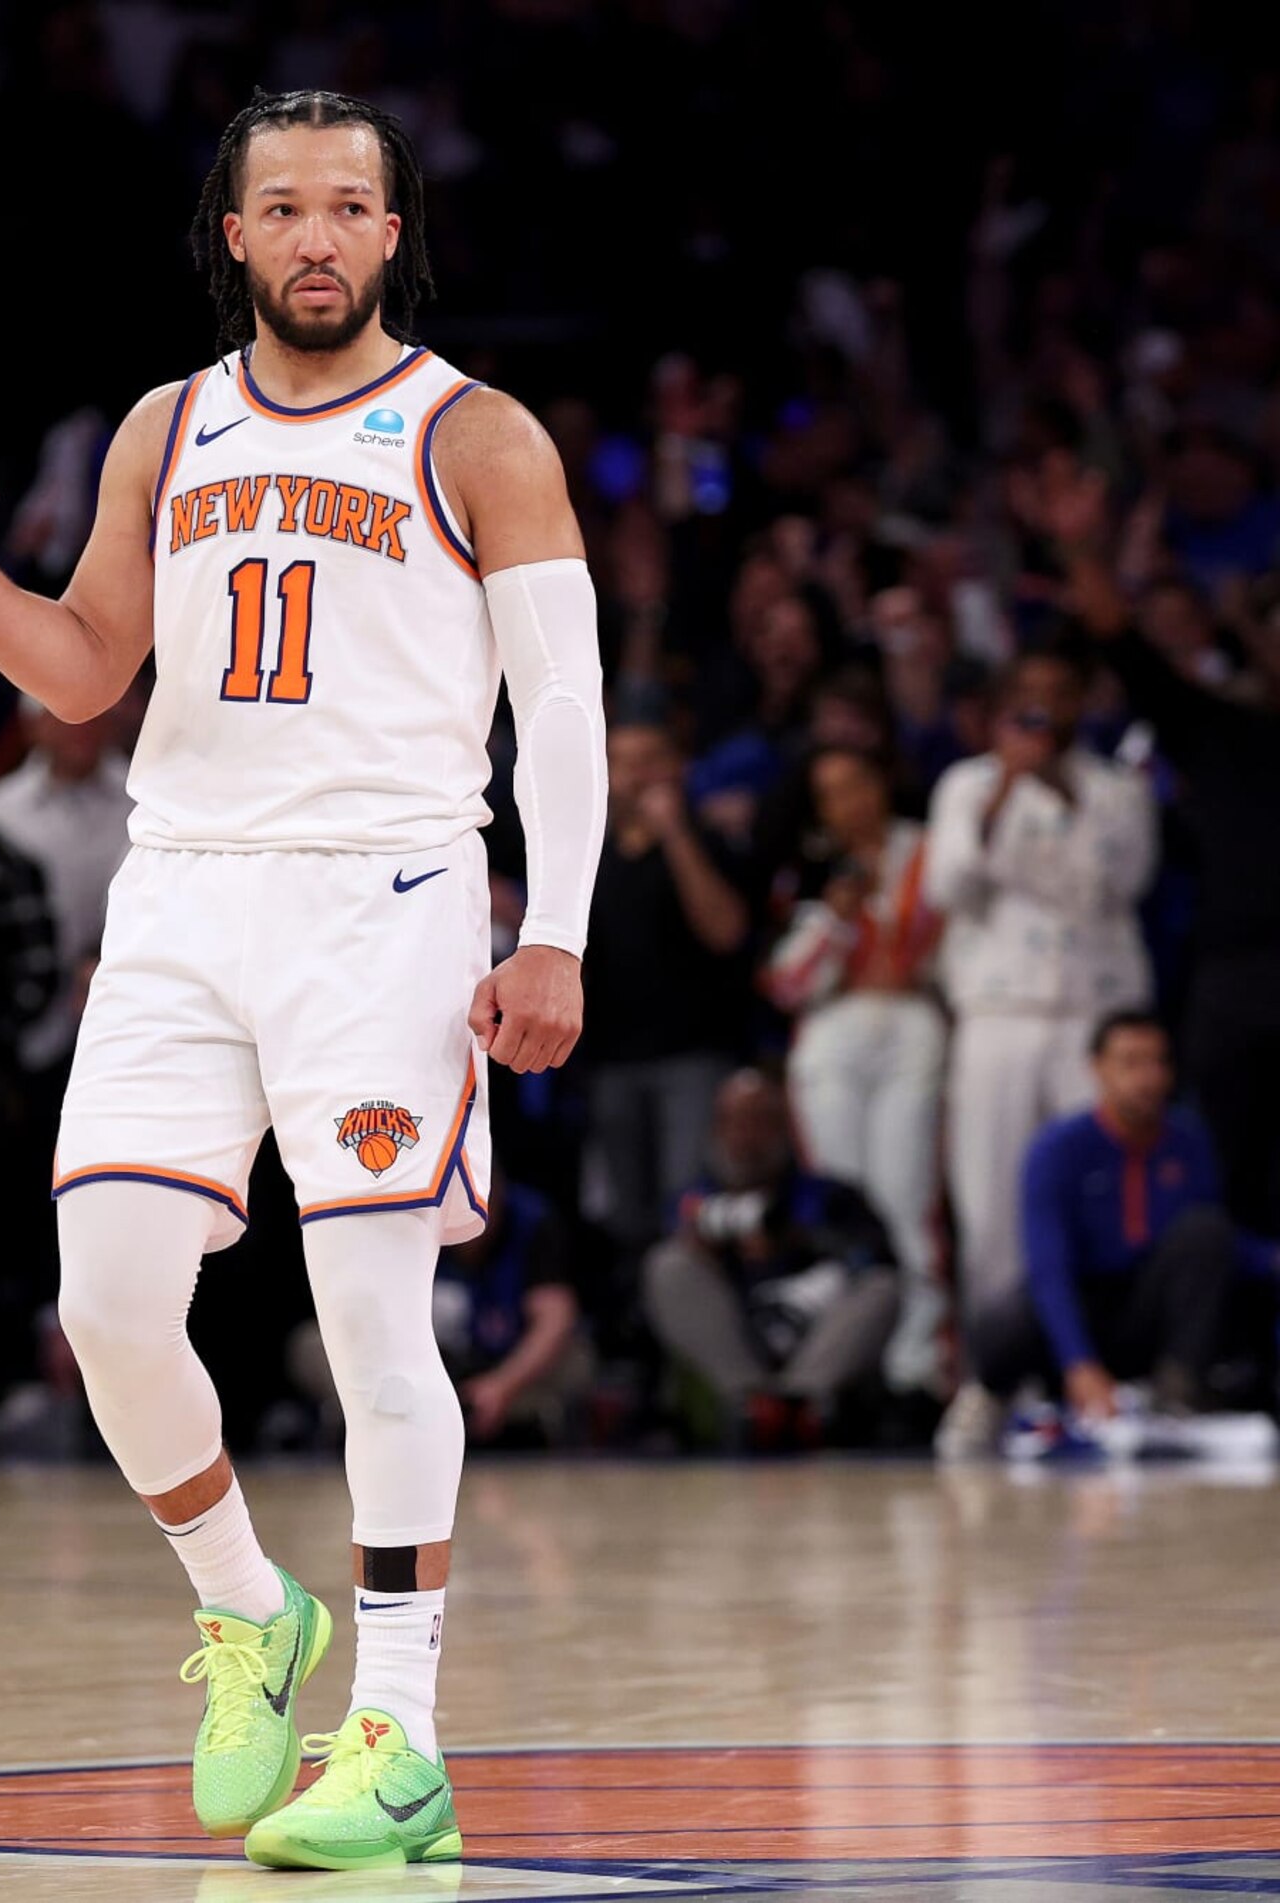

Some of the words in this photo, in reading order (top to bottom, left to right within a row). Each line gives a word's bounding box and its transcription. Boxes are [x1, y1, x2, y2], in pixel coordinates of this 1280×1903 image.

[353, 432, 405, 448] sphere
[170, 475, 270, 554] NEW
[276, 475, 411, 563] YORK
[220, 557, 316, 704] 11
[337, 1107, 420, 1149] KNICKS
